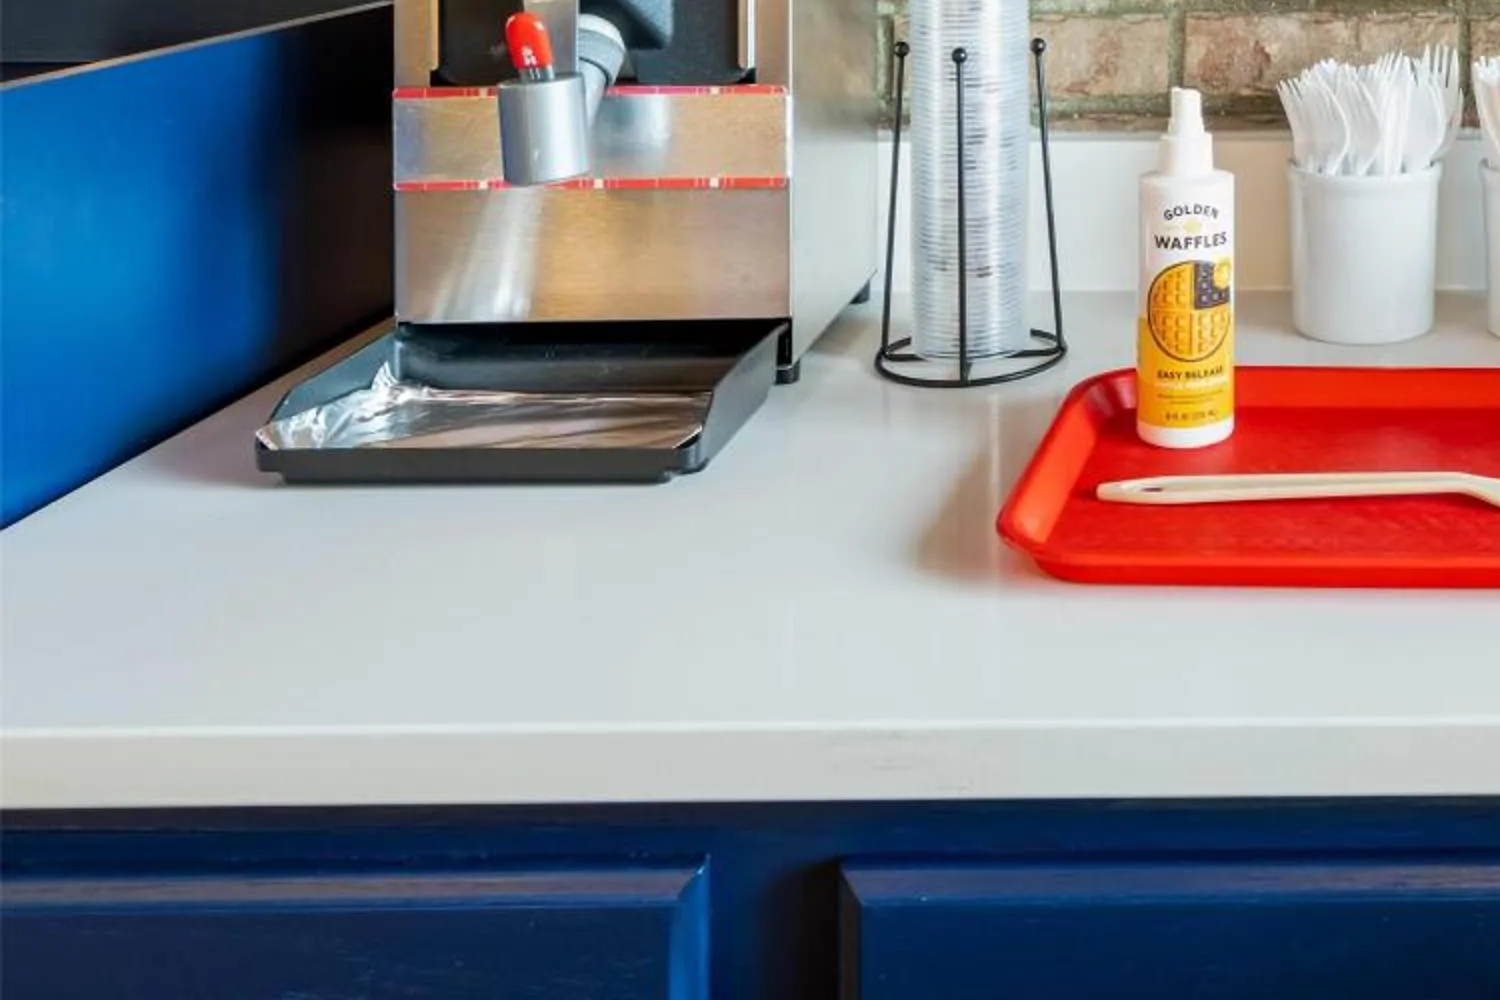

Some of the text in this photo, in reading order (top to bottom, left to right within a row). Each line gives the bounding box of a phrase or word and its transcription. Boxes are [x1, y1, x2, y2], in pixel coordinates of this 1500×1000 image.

[1163, 203, 1219, 221] GOLDEN
[1154, 231, 1228, 250] WAFFLES
[1157, 369, 1182, 380] EASY
